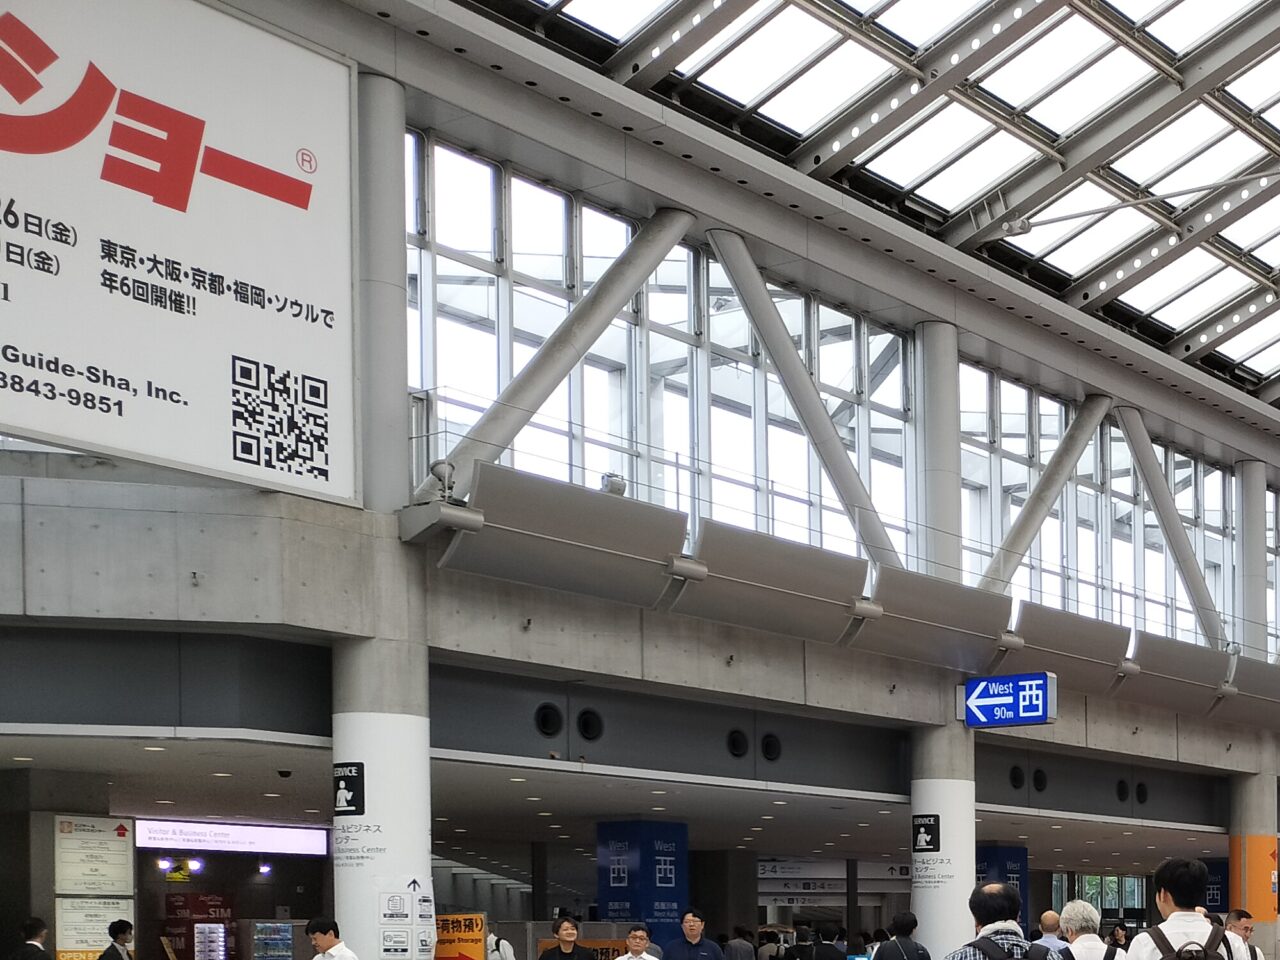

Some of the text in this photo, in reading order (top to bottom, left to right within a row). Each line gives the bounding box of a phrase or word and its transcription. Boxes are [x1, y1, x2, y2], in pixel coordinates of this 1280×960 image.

[0, 198, 77, 247] 6日(金)
[100, 238, 334, 329] 東京・大阪・京都・福岡・ソウルで
[1, 344, 189, 406] Guide-Sha, Inc.
[988, 681, 1014, 695] West
[1018, 680, 1044, 717] 西
[993, 706, 1014, 720] 90m
[361, 845, 387, 853] Center
[654, 840, 676, 852] West
[610, 856, 628, 887] 西
[655, 856, 676, 887] 西
[208, 907, 232, 919] SIM
[60, 952, 86, 960] OPEN
